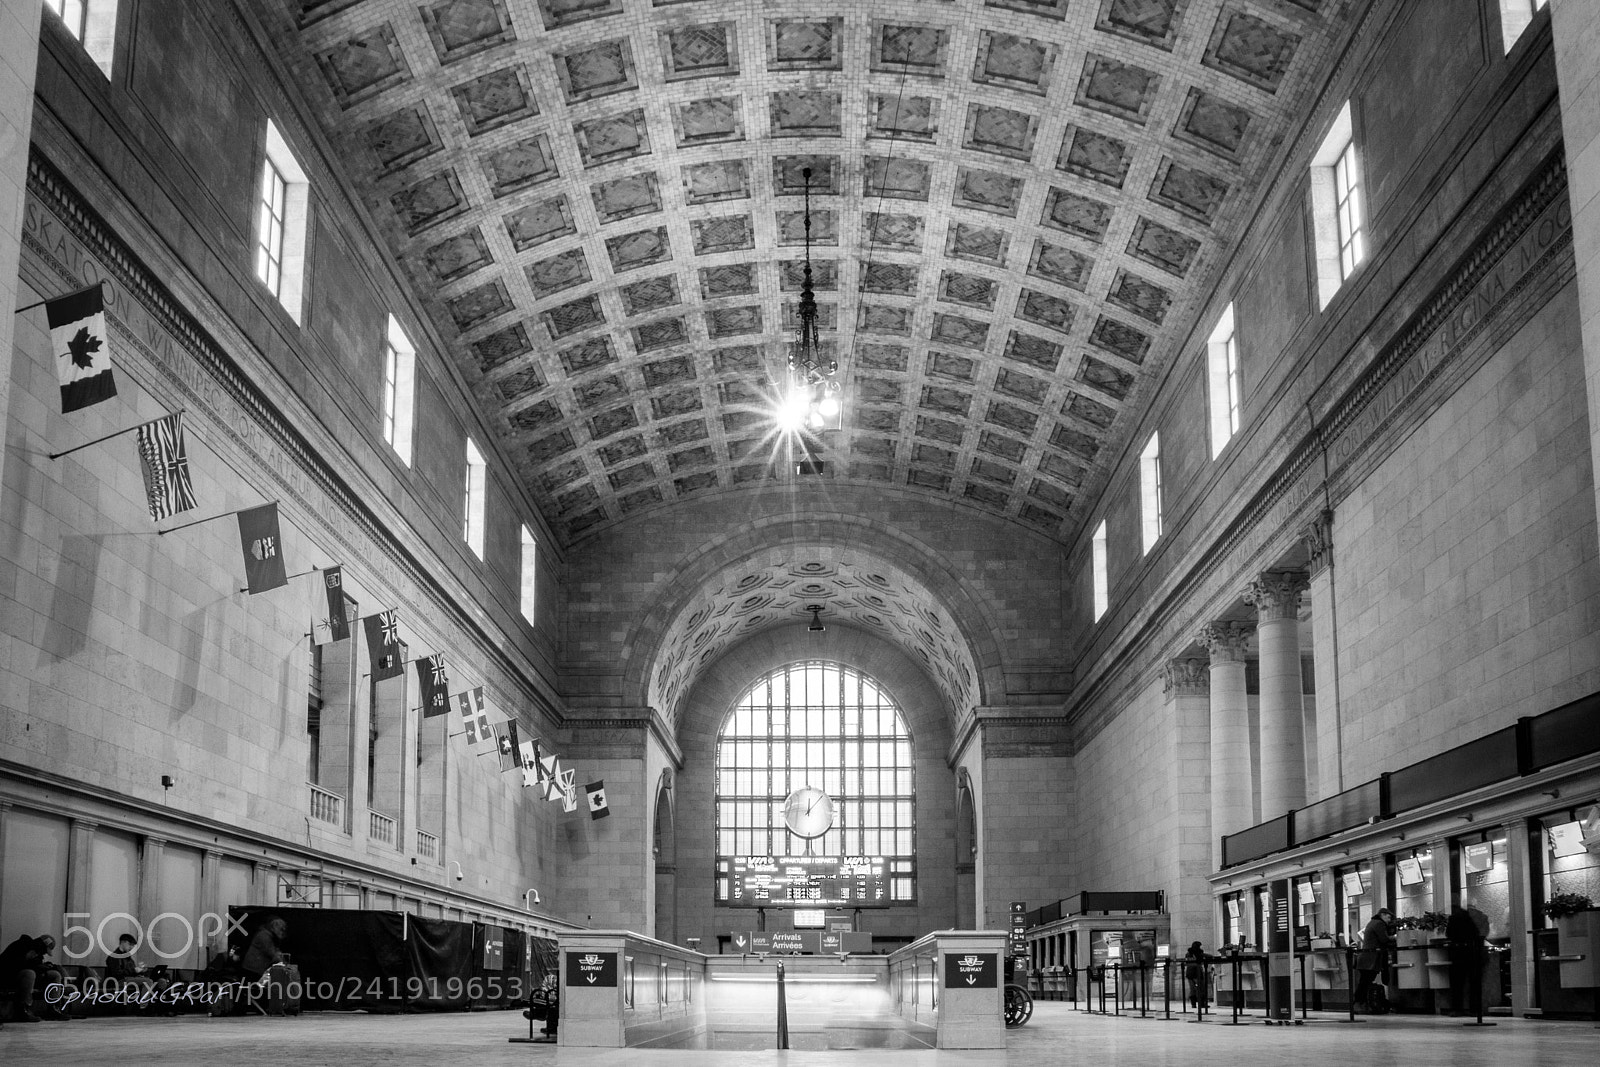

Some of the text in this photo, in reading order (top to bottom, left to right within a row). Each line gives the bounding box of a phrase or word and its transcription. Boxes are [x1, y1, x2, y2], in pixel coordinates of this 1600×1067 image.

[1441, 270, 1505, 355] REGINA
[772, 933, 802, 941] Arrivals
[772, 941, 803, 949] Arrivées
